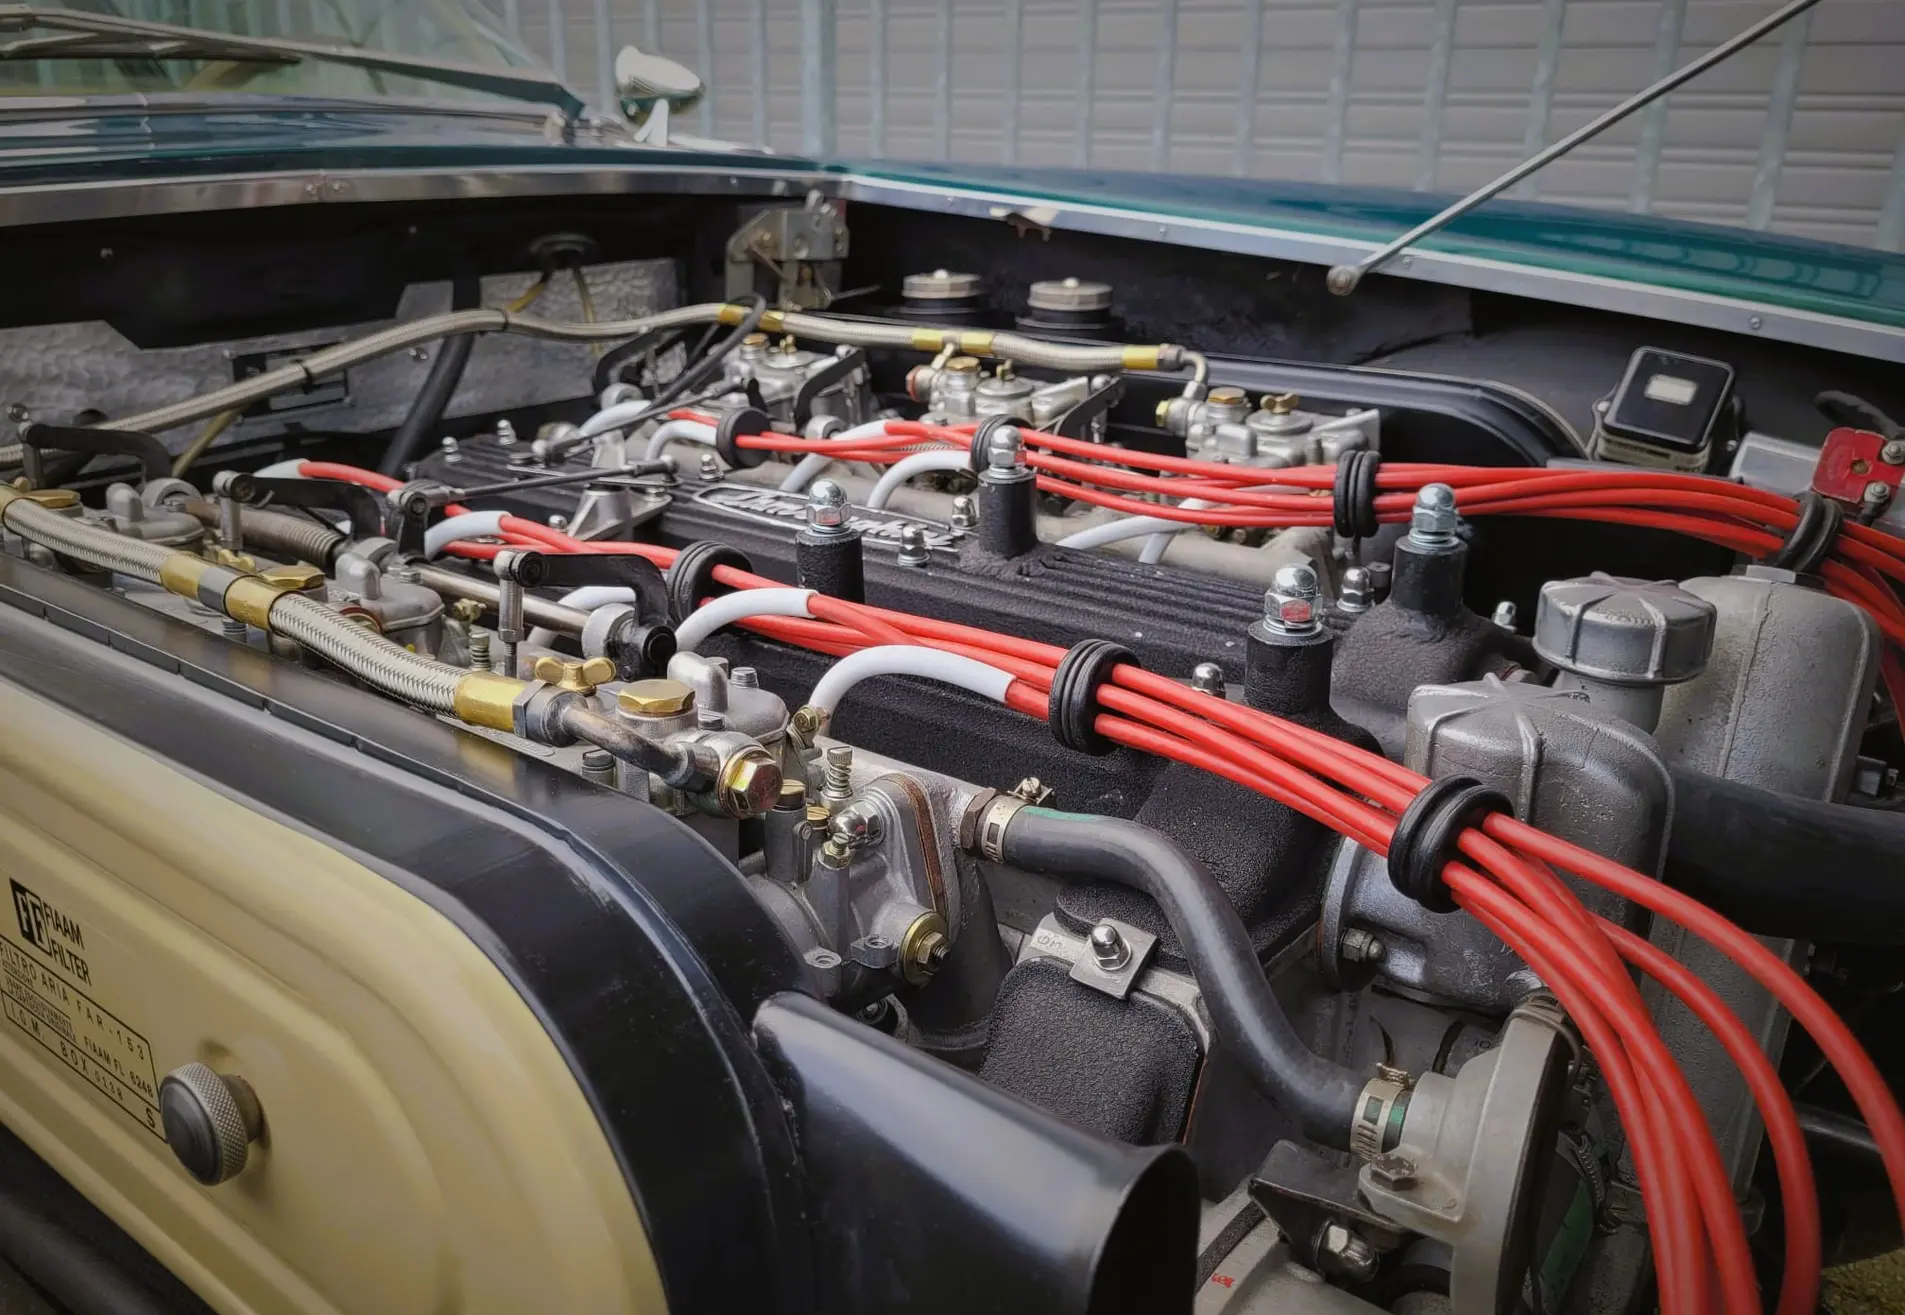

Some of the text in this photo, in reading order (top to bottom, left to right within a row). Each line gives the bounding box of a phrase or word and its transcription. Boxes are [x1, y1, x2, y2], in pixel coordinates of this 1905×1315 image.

[43, 902, 85, 950] FIAAM
[50, 938, 92, 986] FILTER
[41, 972, 69, 1005] ARIA
[84, 1035, 111, 1067] FIAAM
[60, 1041, 89, 1073] BOX
[145, 1107, 155, 1128] S
